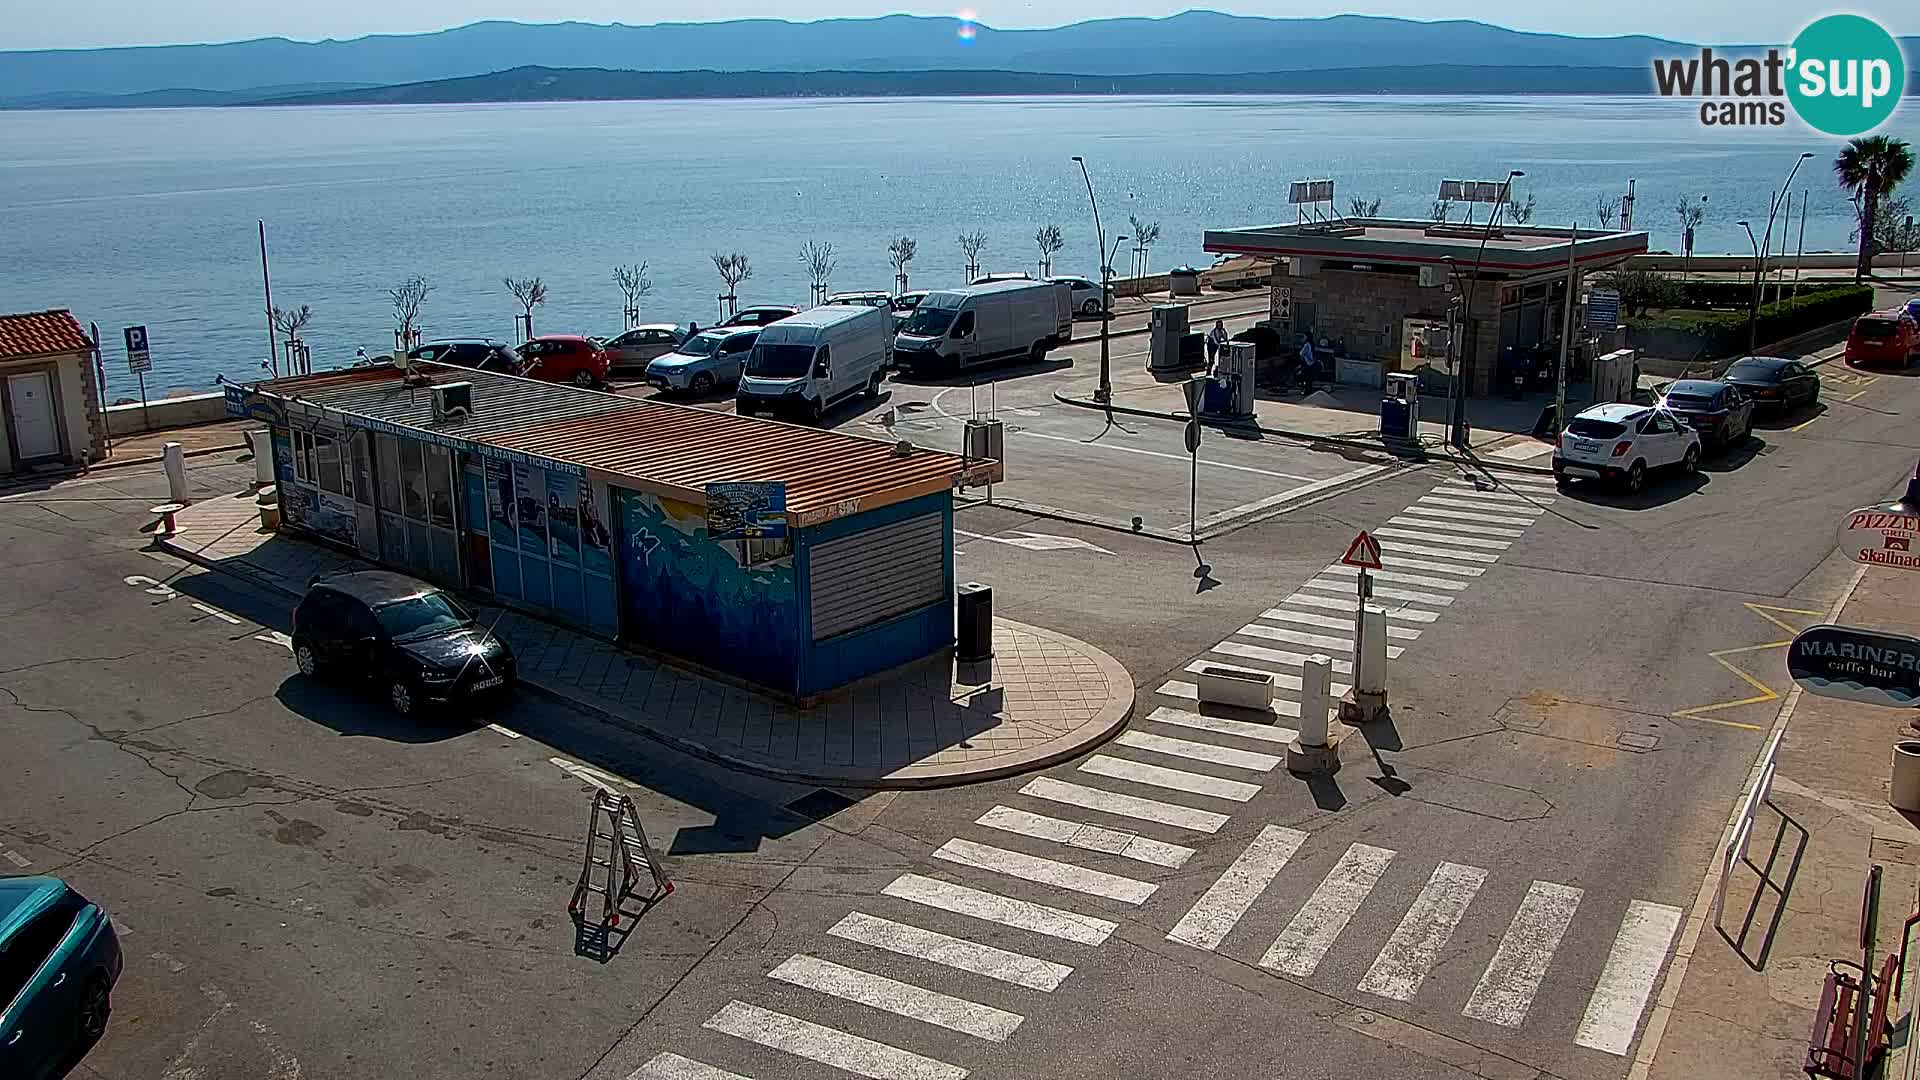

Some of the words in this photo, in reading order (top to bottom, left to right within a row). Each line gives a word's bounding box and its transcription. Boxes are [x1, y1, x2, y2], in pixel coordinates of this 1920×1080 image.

[130, 330, 142, 348] P
[478, 445, 492, 455] BUS
[494, 448, 526, 464] STATION
[528, 456, 554, 470] TICKET
[555, 462, 582, 476] OFFICE
[1847, 514, 1920, 533] PIZZE
[1881, 529, 1917, 539] GRILL
[1828, 661, 1864, 674] caffe
[1870, 664, 1896, 679] bar
